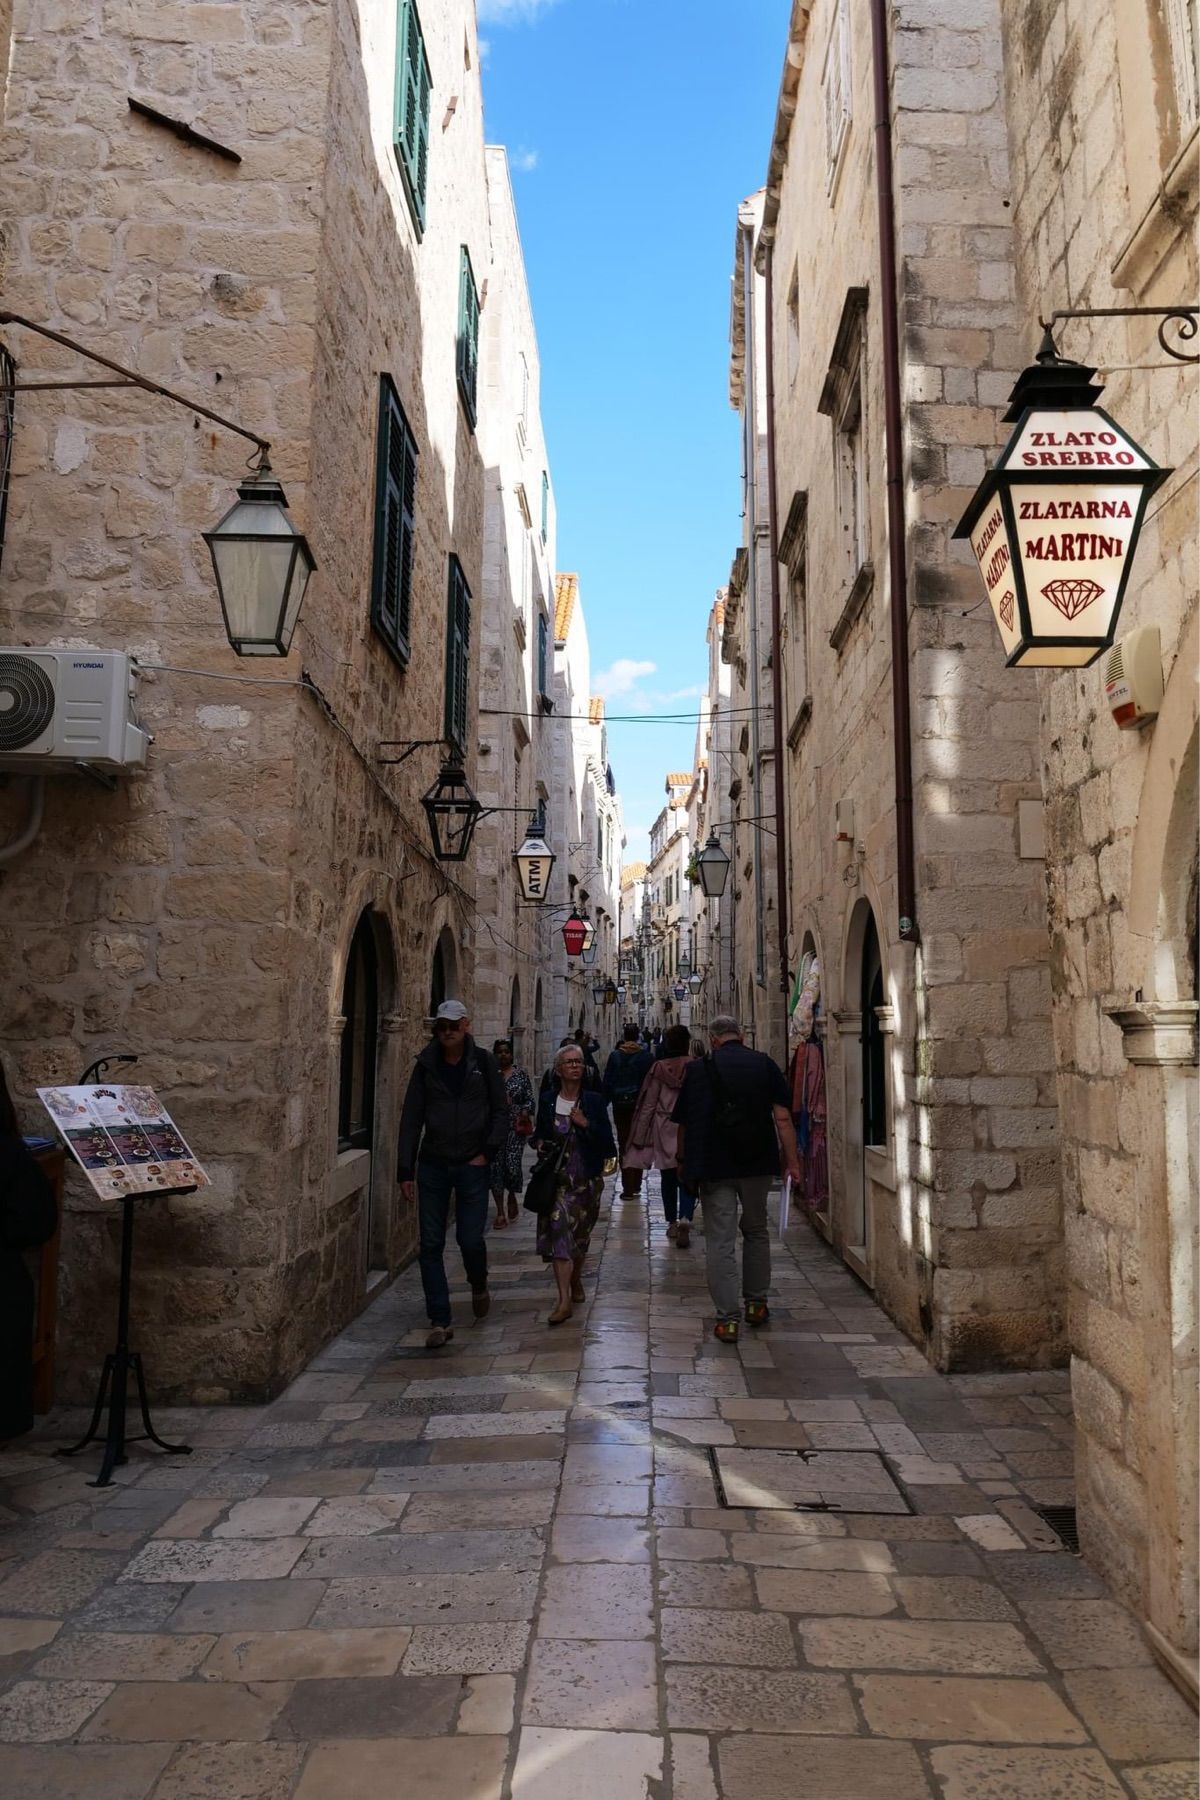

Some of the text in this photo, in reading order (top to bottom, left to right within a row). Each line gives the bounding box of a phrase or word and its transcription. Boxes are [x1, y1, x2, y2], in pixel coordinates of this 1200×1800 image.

[1030, 431, 1117, 446] ZLATO
[1021, 451, 1135, 466] SREBRO
[1019, 501, 1132, 520] ZLATARNA
[976, 508, 1003, 562] ZLATARNA
[1025, 533, 1123, 561] MARTINI
[986, 543, 1010, 592] MARTINI
[528, 860, 541, 894] ATM
